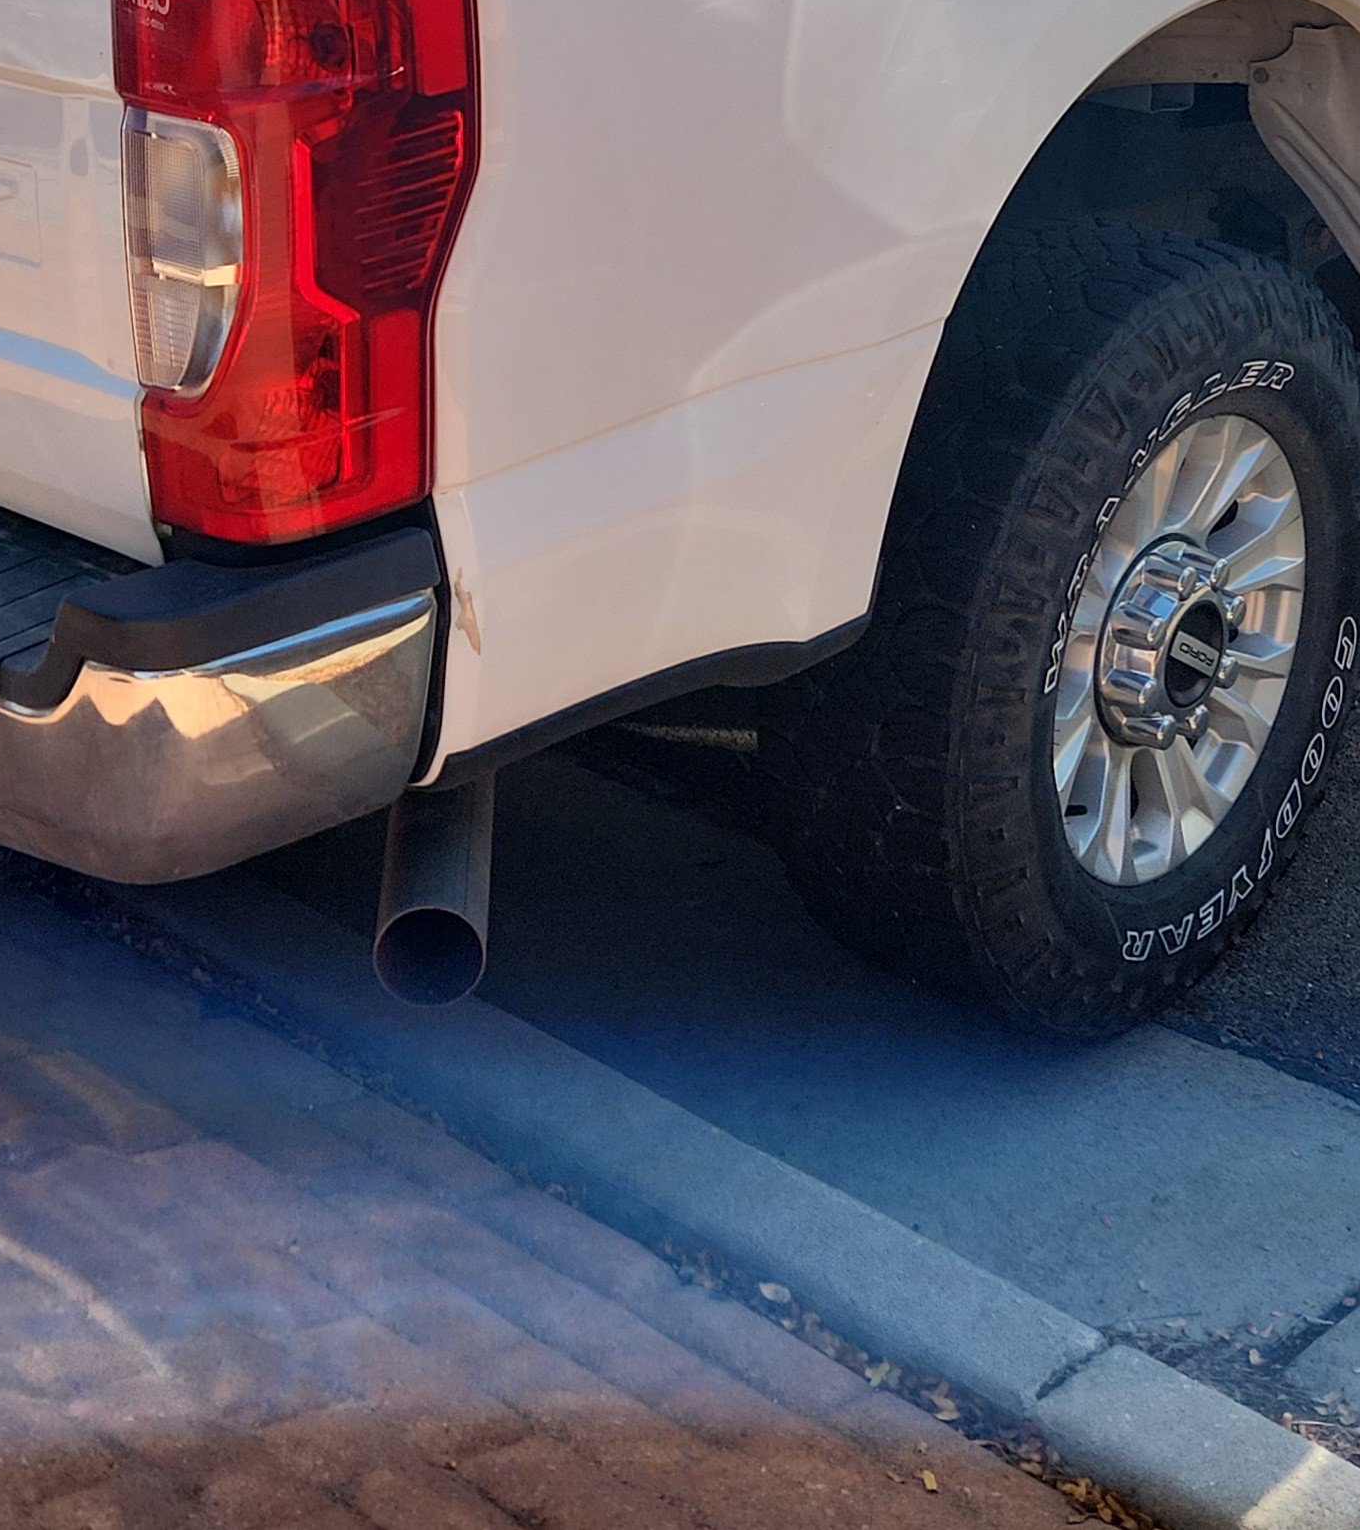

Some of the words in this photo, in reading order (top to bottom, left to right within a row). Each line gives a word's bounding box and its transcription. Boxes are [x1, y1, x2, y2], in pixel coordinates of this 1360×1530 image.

[1043, 359, 1295, 694] WRANGLER
[1179, 641, 1216, 668] FORD
[1122, 616, 1358, 962] GOODYEAR
